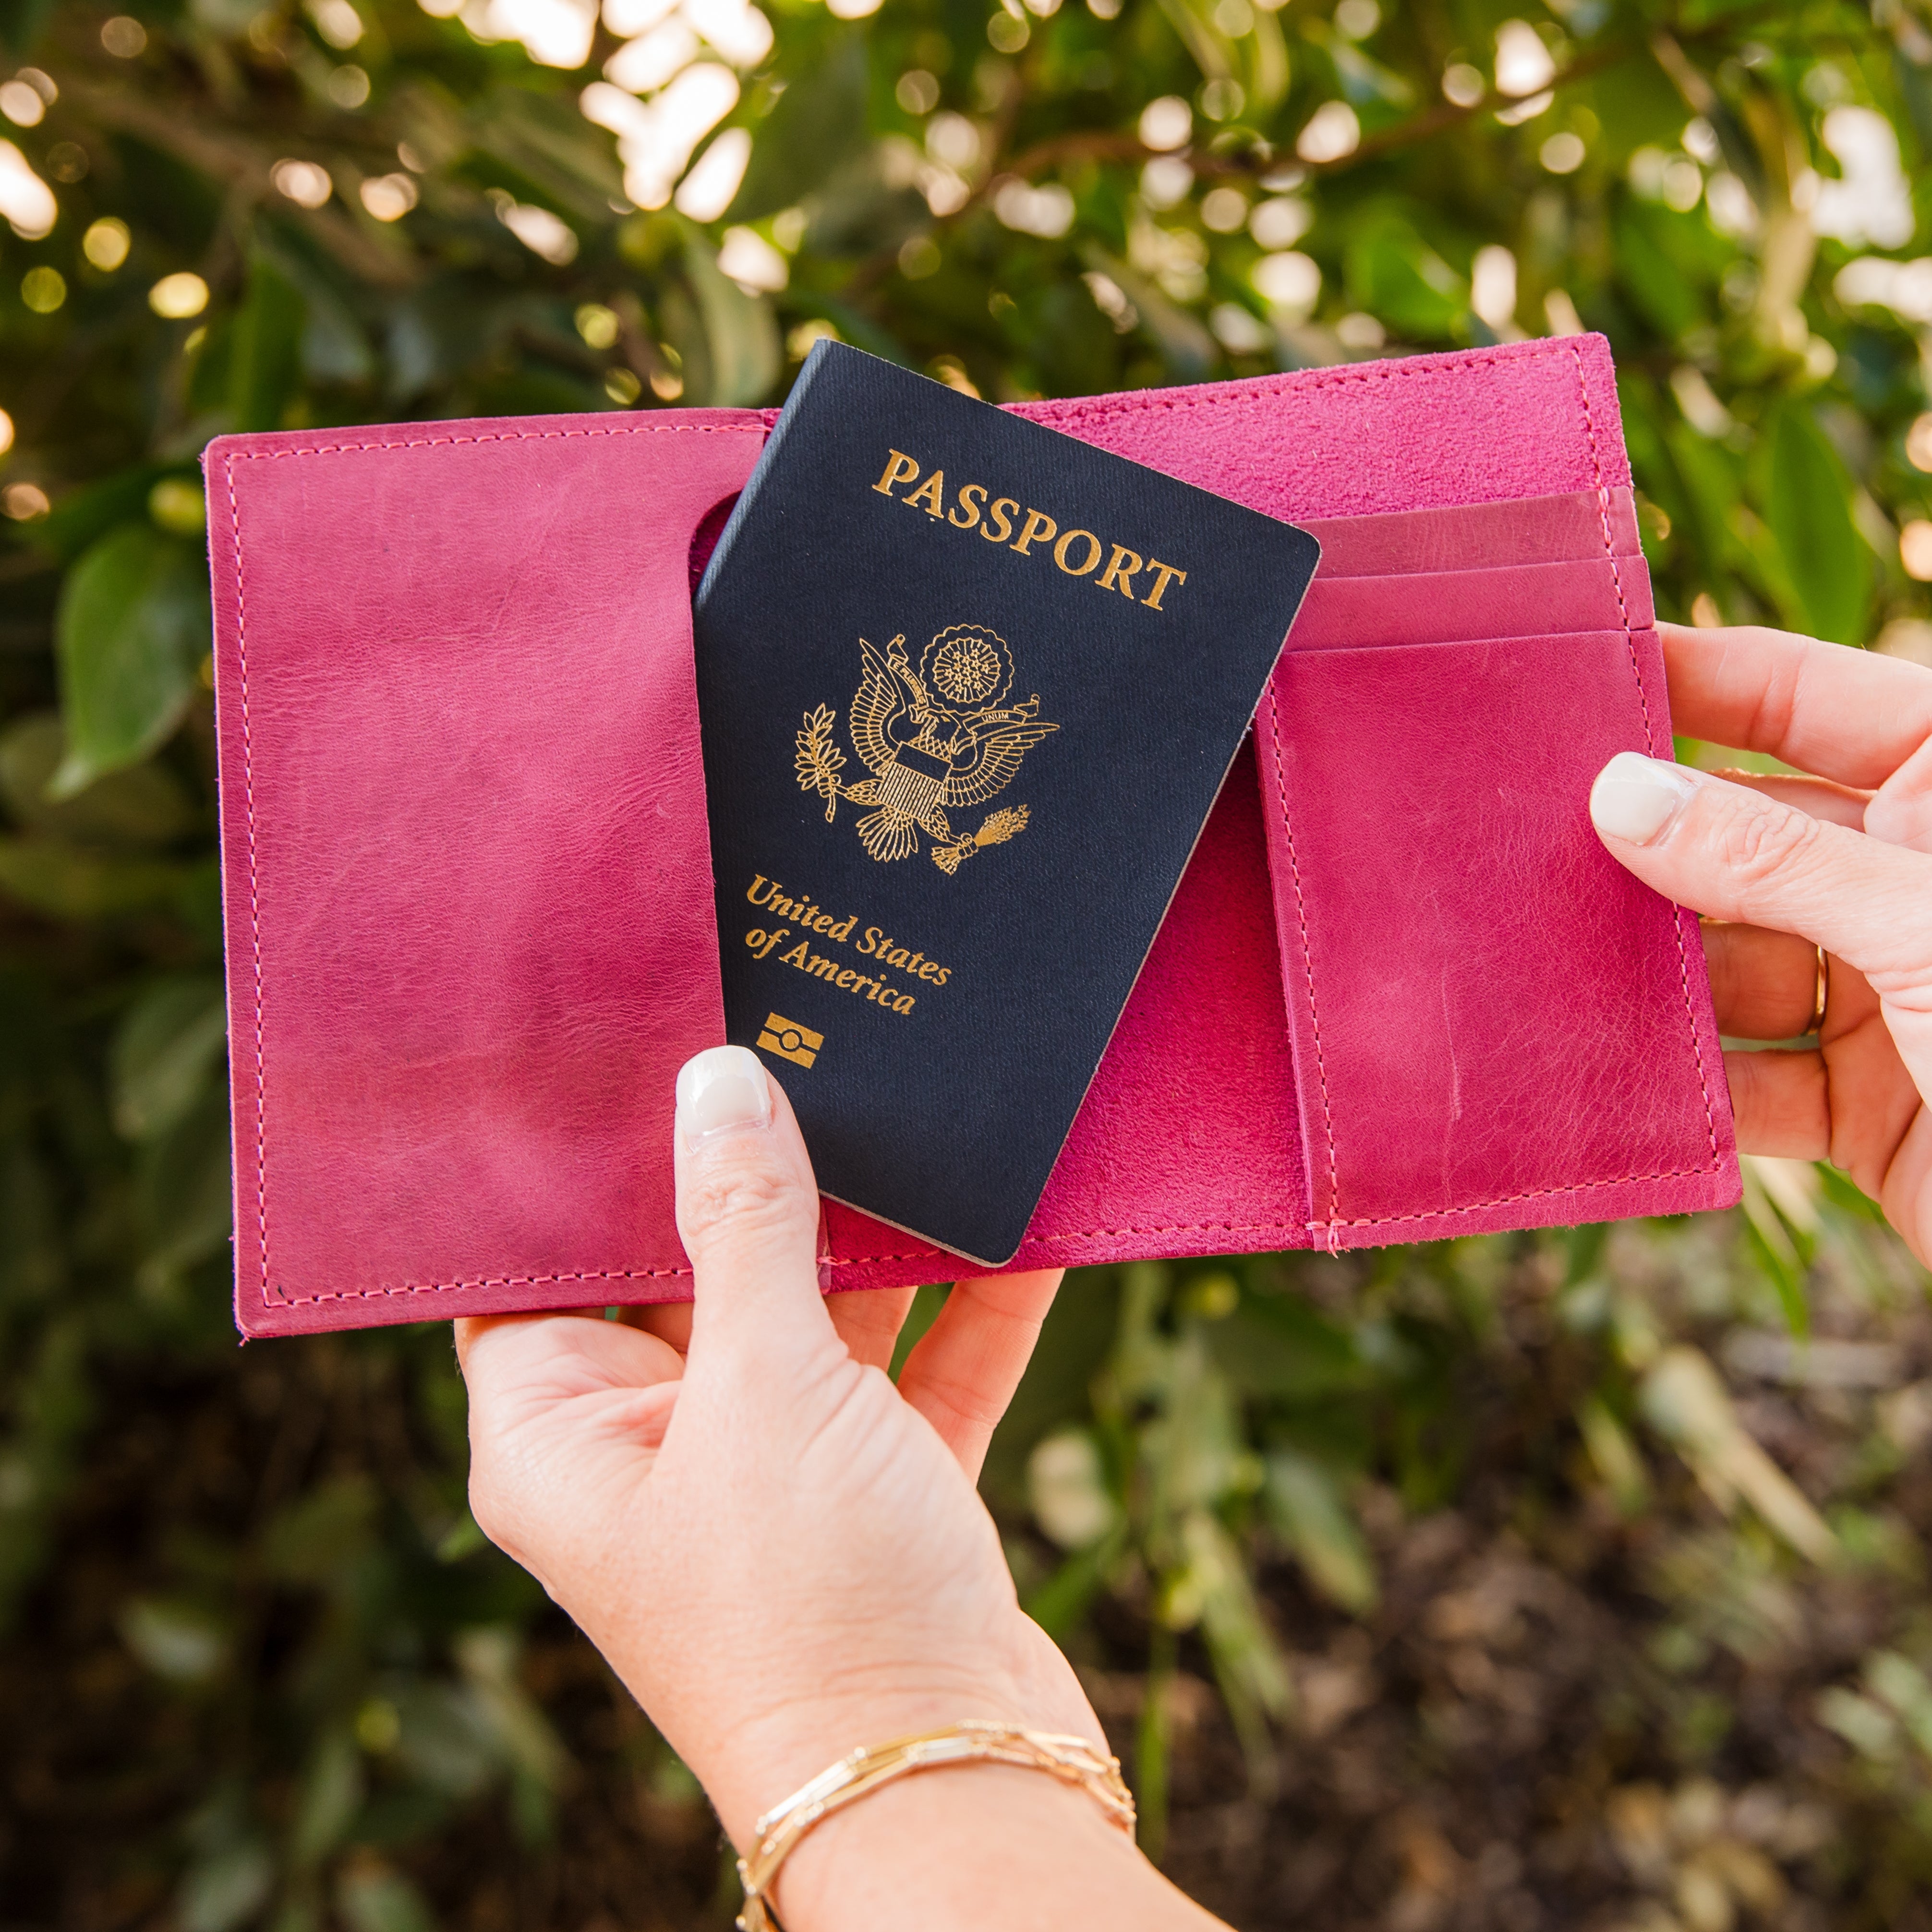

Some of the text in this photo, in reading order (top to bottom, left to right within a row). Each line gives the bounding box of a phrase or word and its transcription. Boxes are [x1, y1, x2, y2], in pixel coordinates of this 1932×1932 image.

[871, 448, 1187, 611] PASSPORT
[893, 662, 901, 670] E
[981, 712, 1009, 723] UNUM
[745, 929, 916, 1015] of America
[747, 874, 952, 986] United States
